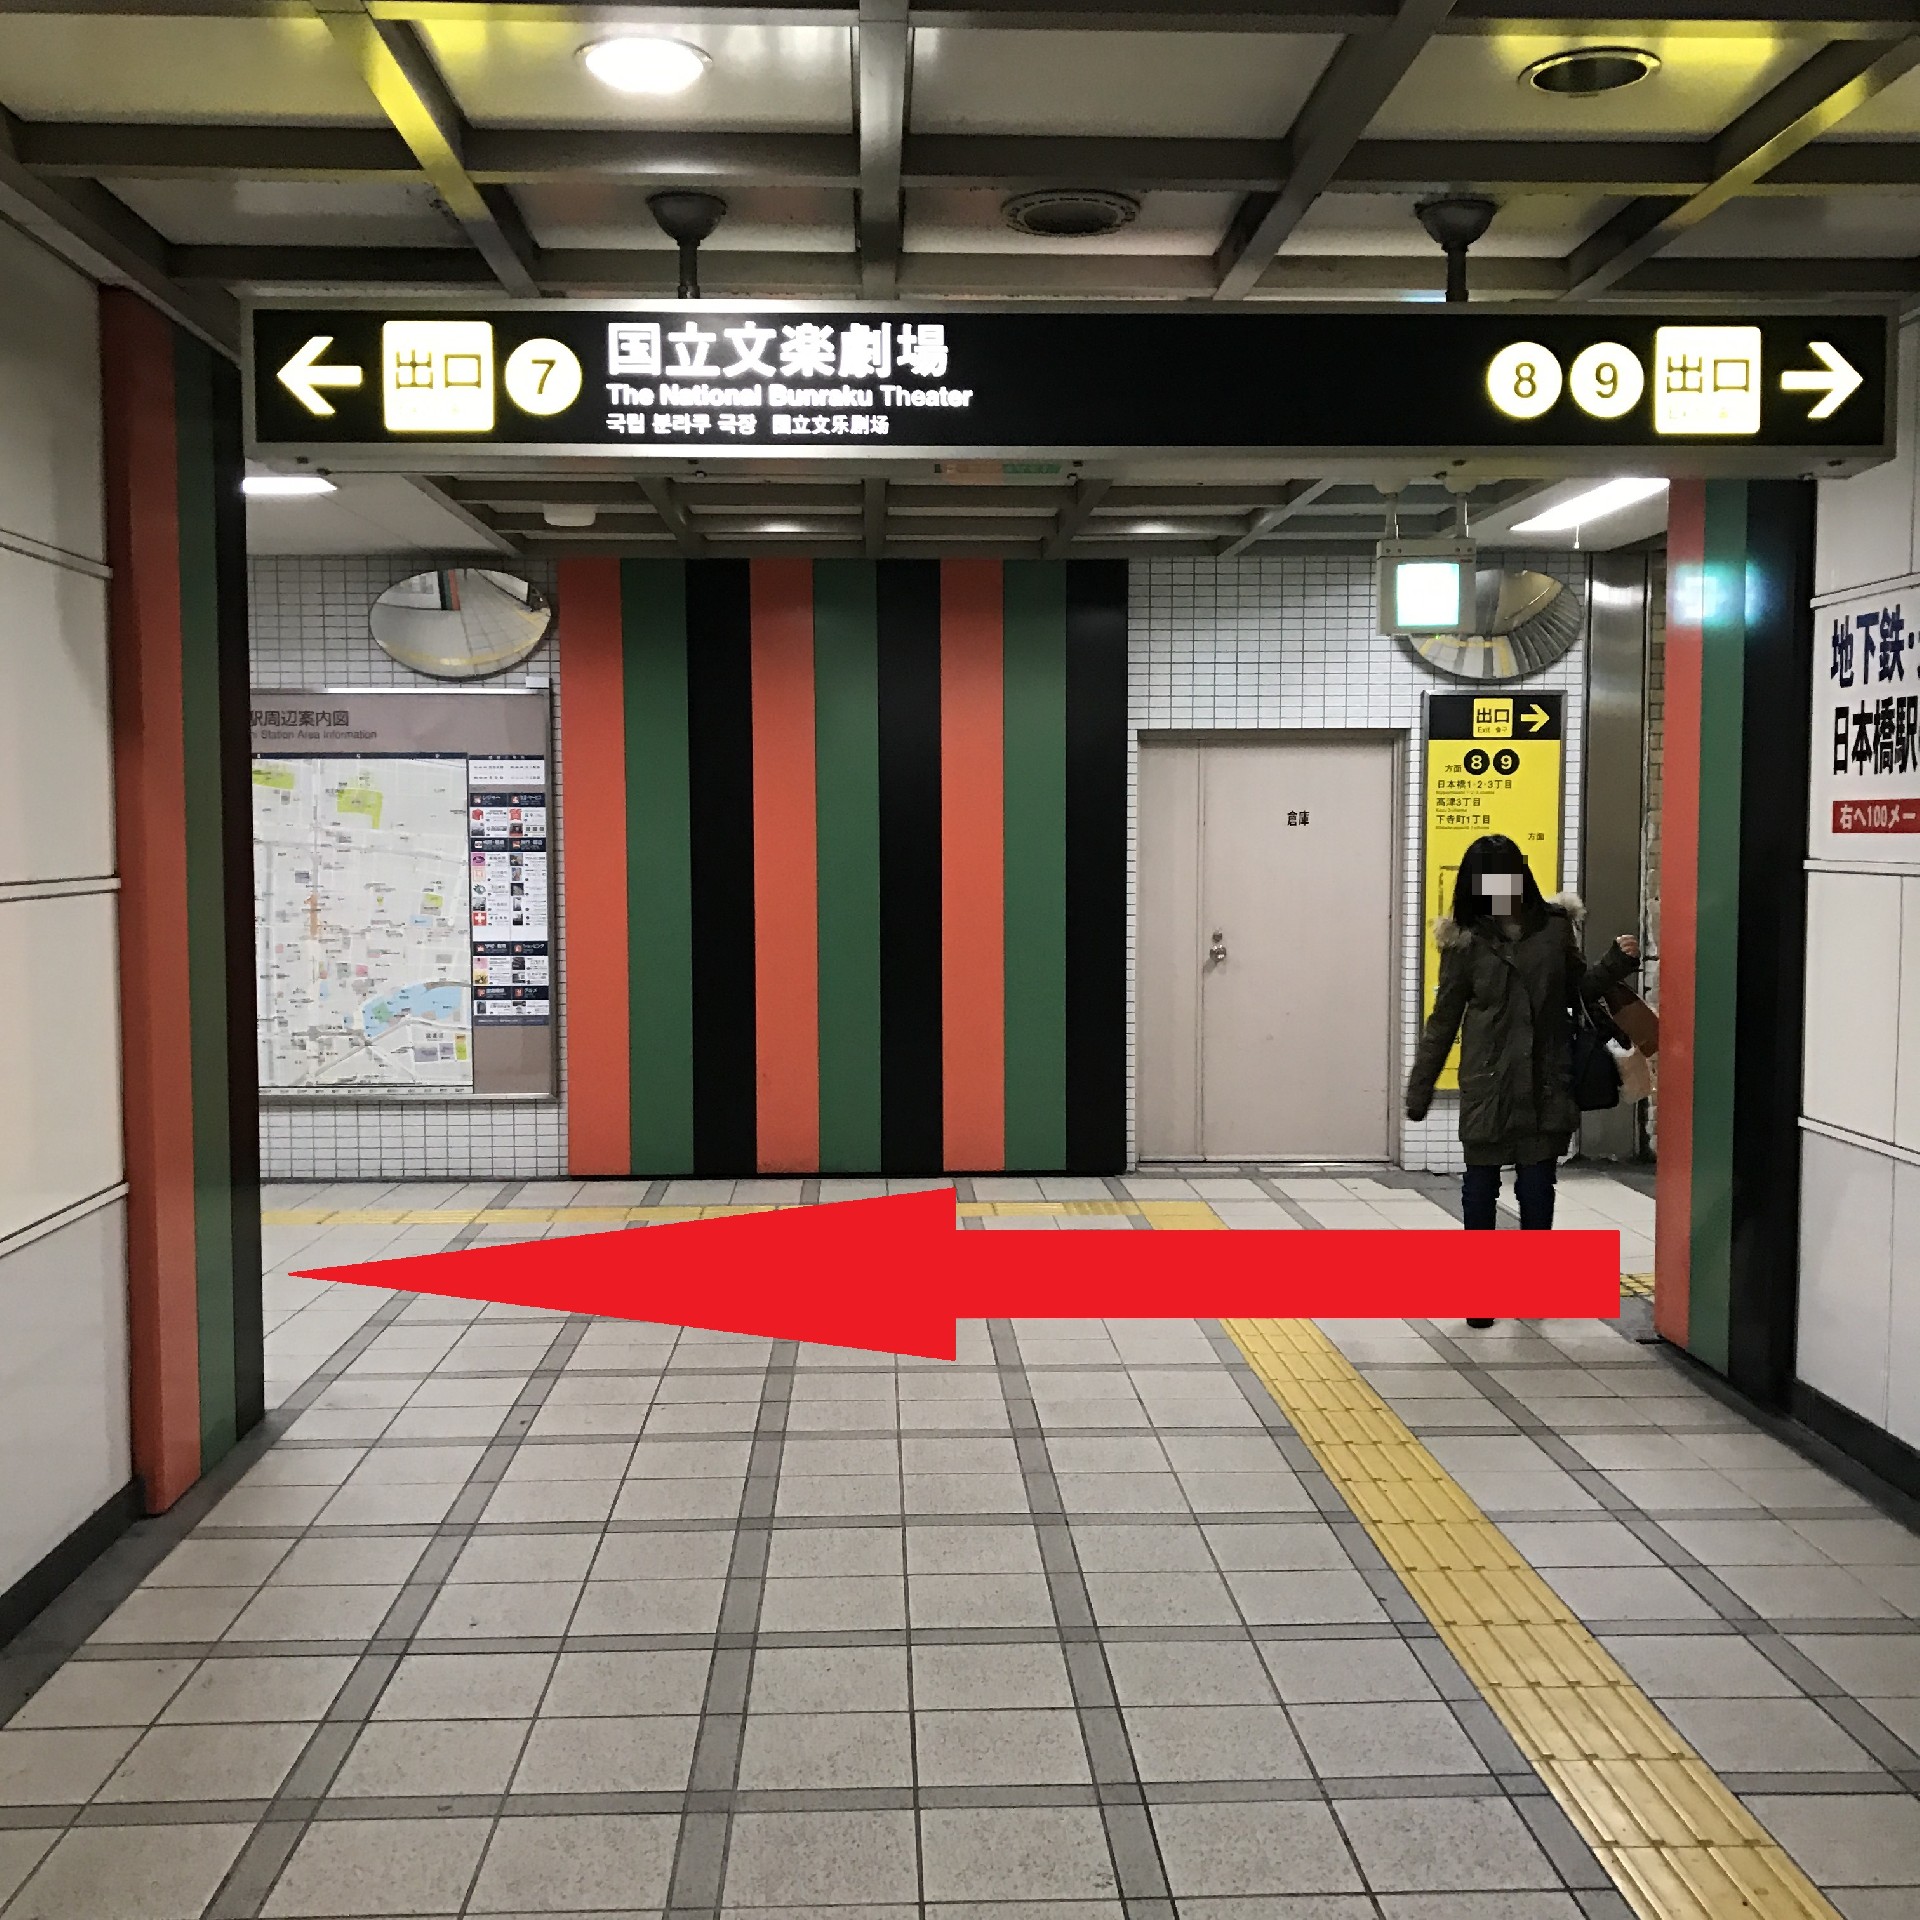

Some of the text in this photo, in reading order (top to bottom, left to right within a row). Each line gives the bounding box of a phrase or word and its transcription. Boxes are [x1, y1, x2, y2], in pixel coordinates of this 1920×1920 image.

[607, 320, 950, 378] 国立文楽劇場
[394, 349, 557, 397] 出口 7
[1512, 353, 1751, 399] 8 9 出口
[605, 383, 974, 408] The National Bunraku Theater
[605, 412, 646, 434] 국립
[717, 412, 757, 436] 극장
[1830, 603, 1920, 689] 地下鉄・
[1475, 707, 1510, 724] 出口
[261, 729, 294, 740] Station
[297, 729, 320, 740] Area
[323, 729, 377, 740] Information
[1477, 726, 1491, 734] Exit
[1833, 694, 1919, 776] 日本橋駅
[1444, 754, 1513, 773] 方面 8 9
[1287, 810, 1310, 827] 倉庫
[1839, 803, 1917, 830] 右へ100メー
